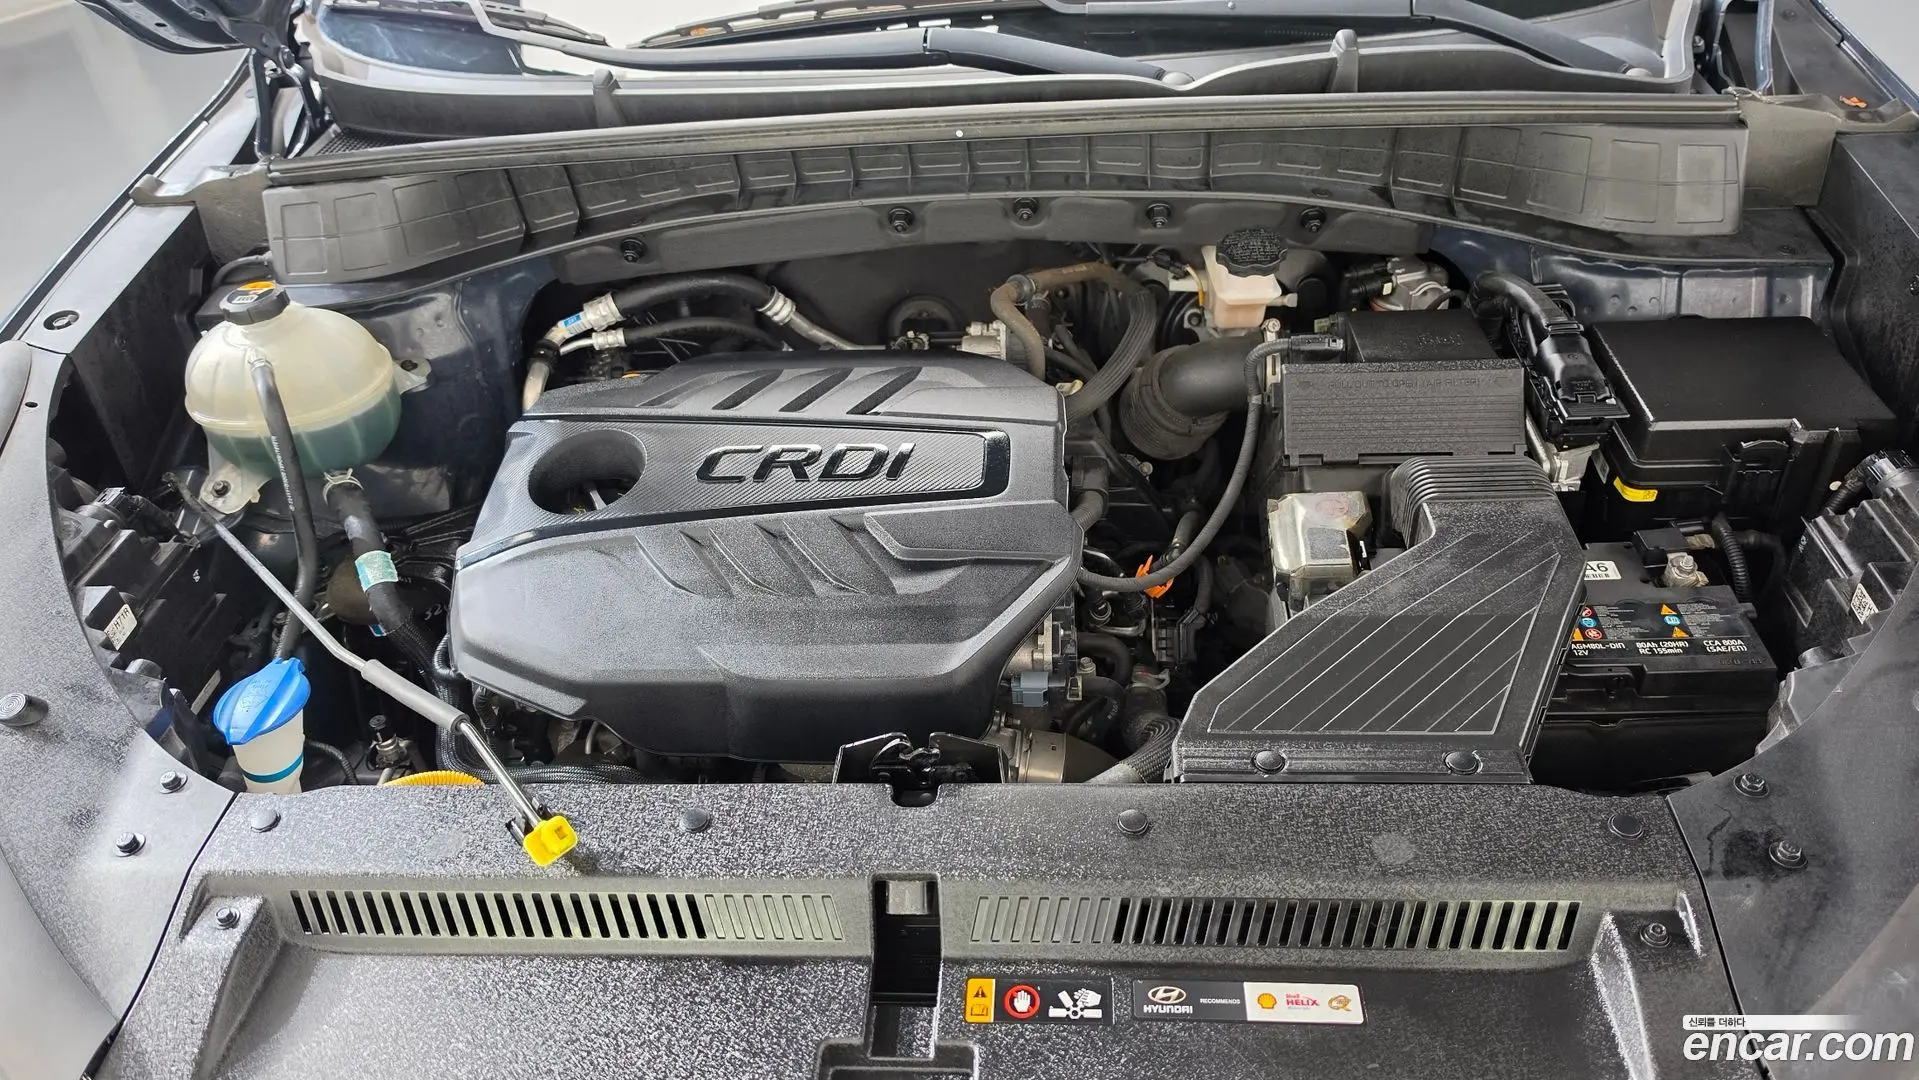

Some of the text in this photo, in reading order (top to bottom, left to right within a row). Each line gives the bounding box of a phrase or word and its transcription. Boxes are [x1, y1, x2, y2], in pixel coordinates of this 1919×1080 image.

[696, 442, 917, 484] CRDI
[1659, 640, 1690, 648] (20HR)
[1703, 639, 1721, 647] CCA
[1143, 1004, 1194, 1014] HYUNDAI
